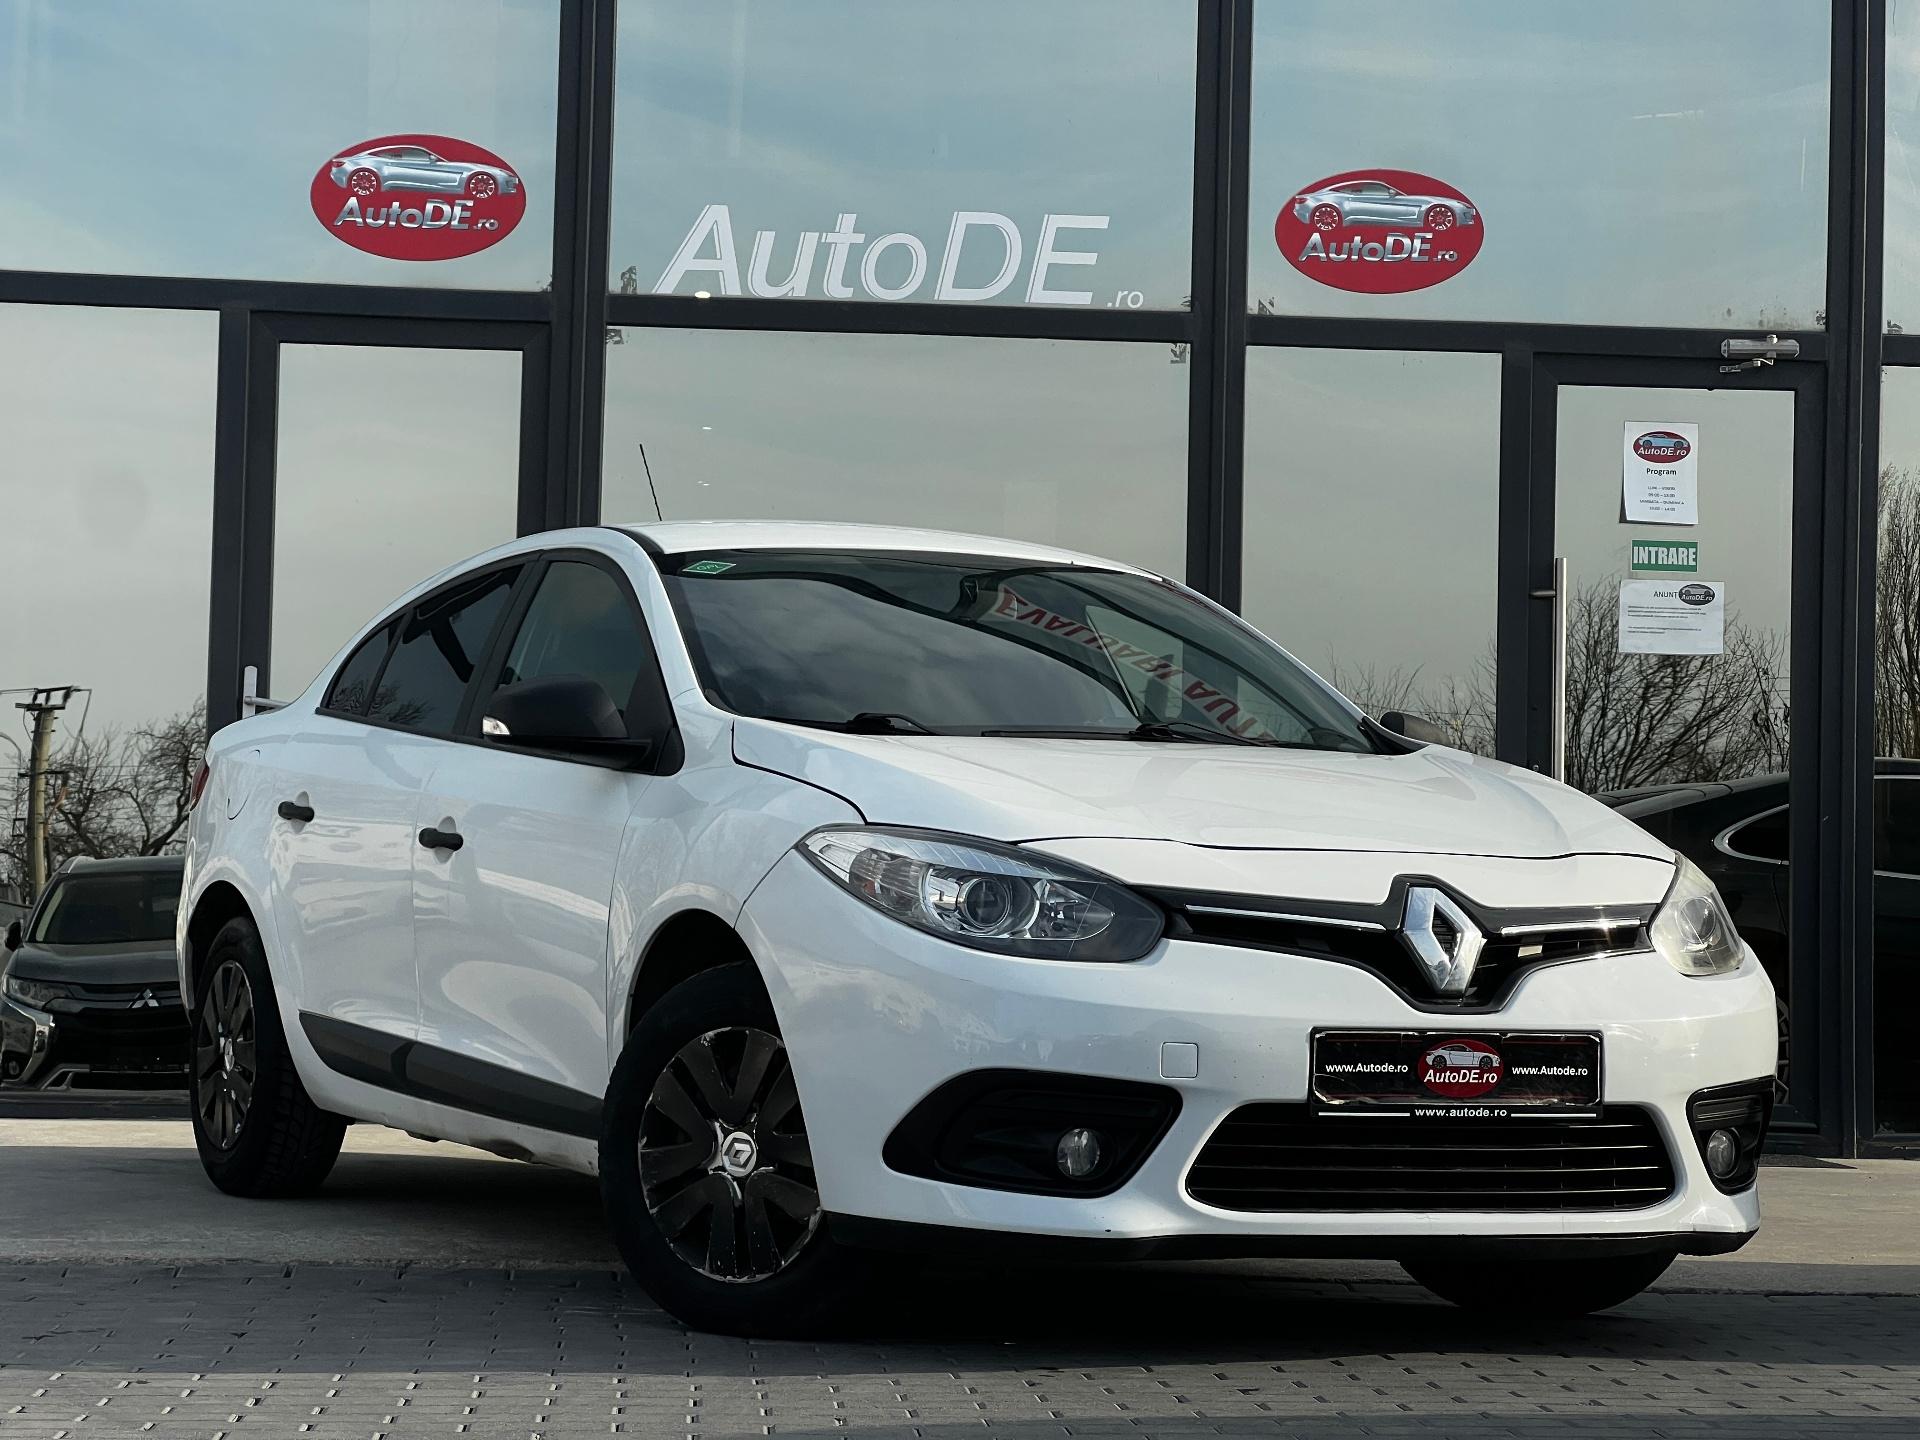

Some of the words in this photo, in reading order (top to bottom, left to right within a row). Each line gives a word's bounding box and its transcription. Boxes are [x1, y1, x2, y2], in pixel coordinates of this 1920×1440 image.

[1646, 467, 1677, 476] Program
[1633, 546, 1697, 566] INTRARE
[1325, 1062, 1409, 1074] www.Autode.ro
[1424, 1069, 1498, 1084] AutoDE.ro
[1511, 1066, 1589, 1077] www.Autode.ro
[1414, 1107, 1508, 1118] www.autode.ro
